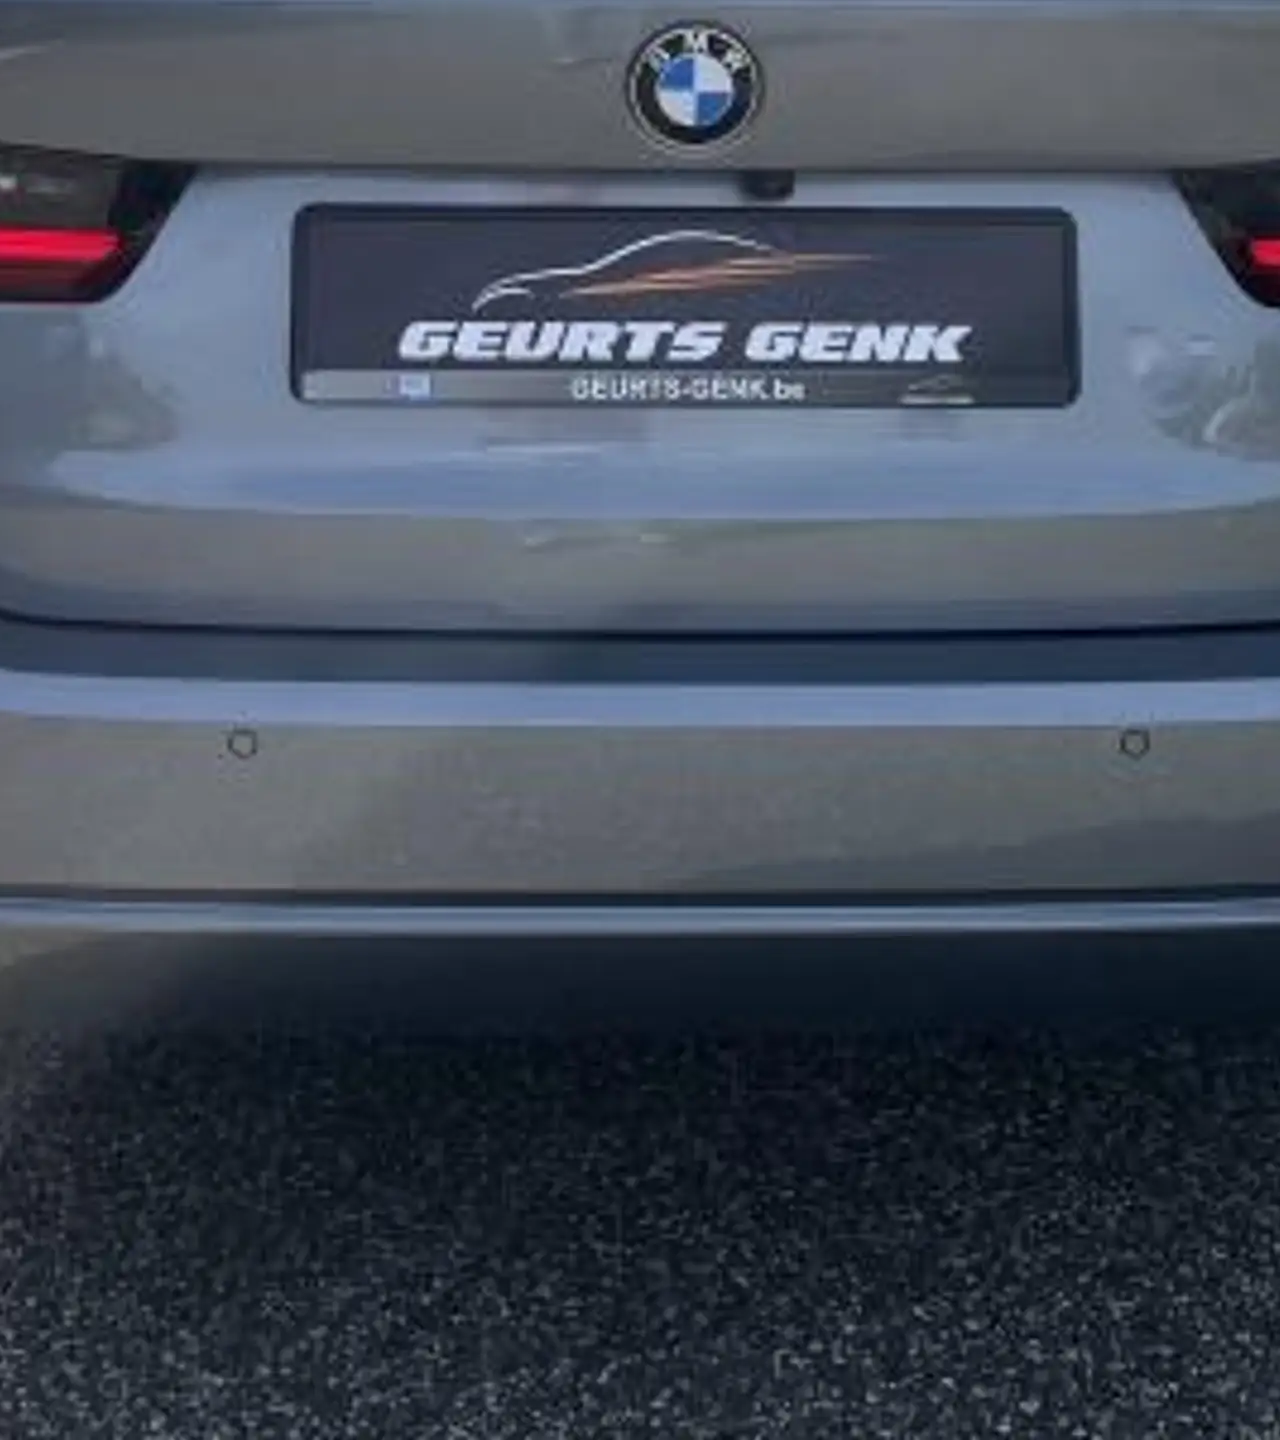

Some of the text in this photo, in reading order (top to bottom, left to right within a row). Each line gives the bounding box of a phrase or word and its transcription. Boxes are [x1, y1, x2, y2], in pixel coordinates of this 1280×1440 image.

[397, 320, 973, 362] GEURTS GENK
[571, 376, 806, 401] GEURTS-GENK.be
